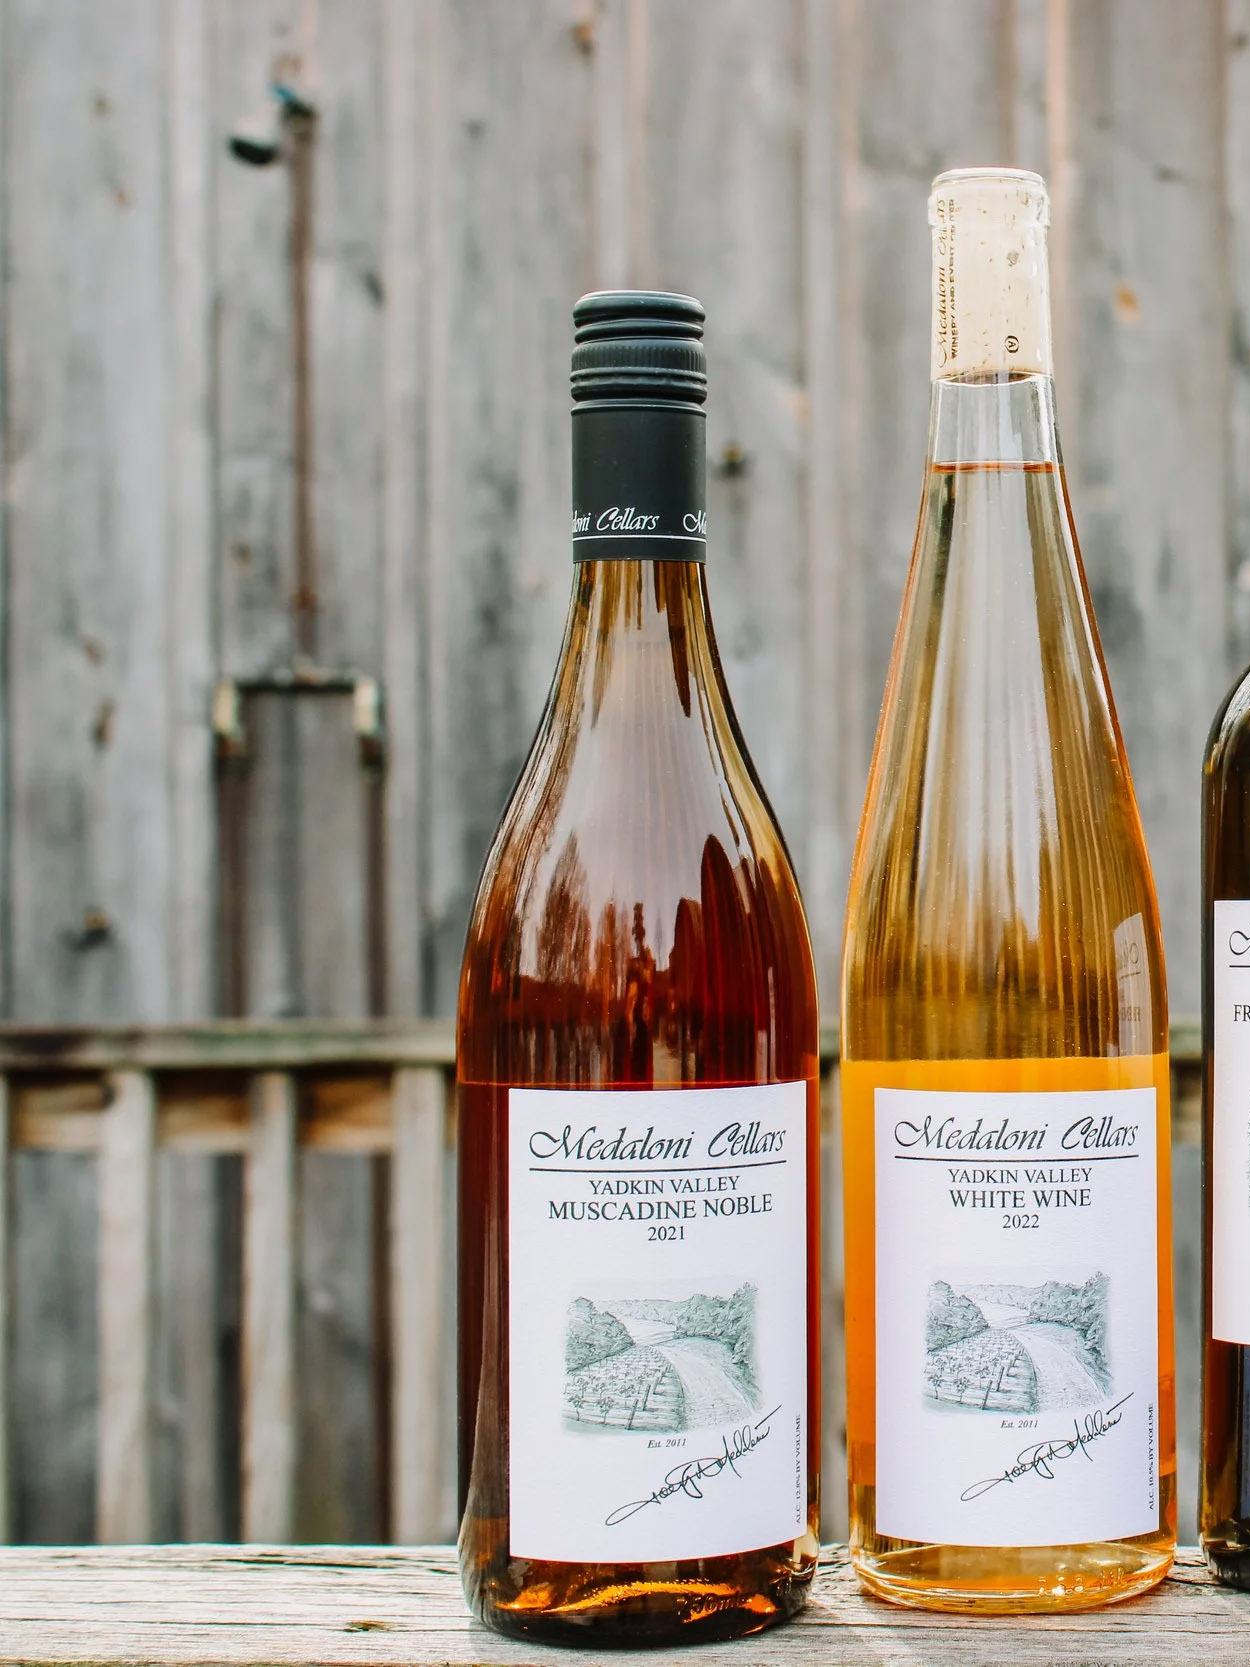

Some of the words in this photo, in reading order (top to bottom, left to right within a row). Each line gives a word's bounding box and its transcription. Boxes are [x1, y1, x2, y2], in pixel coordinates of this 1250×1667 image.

[948, 246, 956, 283] EVENT
[949, 286, 957, 311] AND
[949, 315, 959, 360] WINERY
[596, 506, 660, 531] Cellars
[528, 1124, 695, 1161] Medaloni
[707, 1120, 787, 1161] Cellars
[894, 1115, 1049, 1151] Medaloni
[1060, 1115, 1139, 1150] Cellars
[588, 1179, 665, 1196] YADKIN
[669, 1175, 740, 1194] VALLEY
[947, 1168, 1019, 1184] YADKIN
[1023, 1167, 1093, 1184] VALLEY
[548, 1199, 697, 1221] MUSCADINE
[702, 1193, 773, 1218] NOBLE
[948, 1189, 1026, 1209] WHITE
[1032, 1188, 1092, 1208] WINE
[1002, 1213, 1040, 1229] 2022
[647, 1225, 685, 1242] 2021
[1018, 1419, 1039, 1429] 2011
[664, 1437, 688, 1449] 2011
[1148, 1447, 1154, 1460] BY
